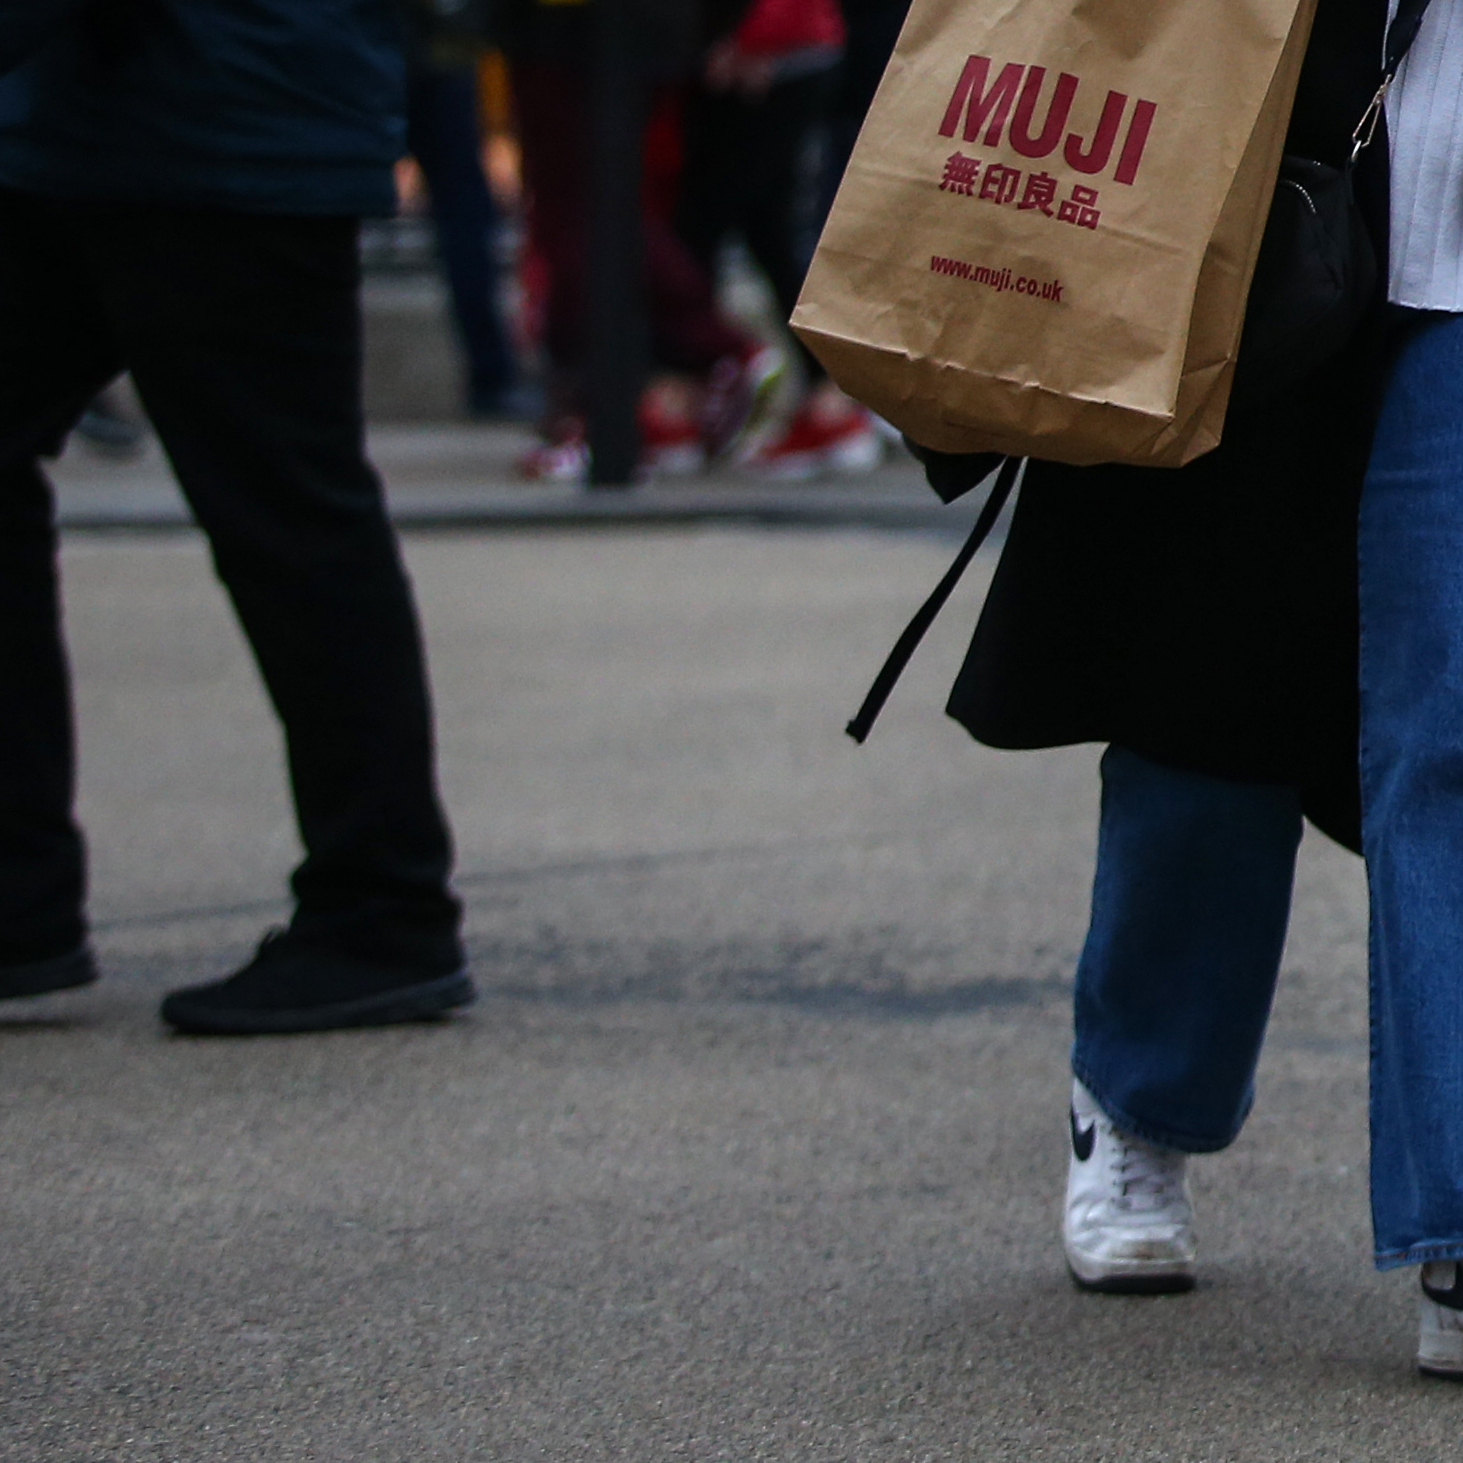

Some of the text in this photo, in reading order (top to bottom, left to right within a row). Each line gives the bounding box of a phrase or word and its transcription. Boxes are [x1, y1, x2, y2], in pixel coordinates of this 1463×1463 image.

[937, 53, 1158, 187] MUJI
[937, 150, 1101, 231] 無印良品
[929, 254, 1065, 304] www.muji.co.uk
